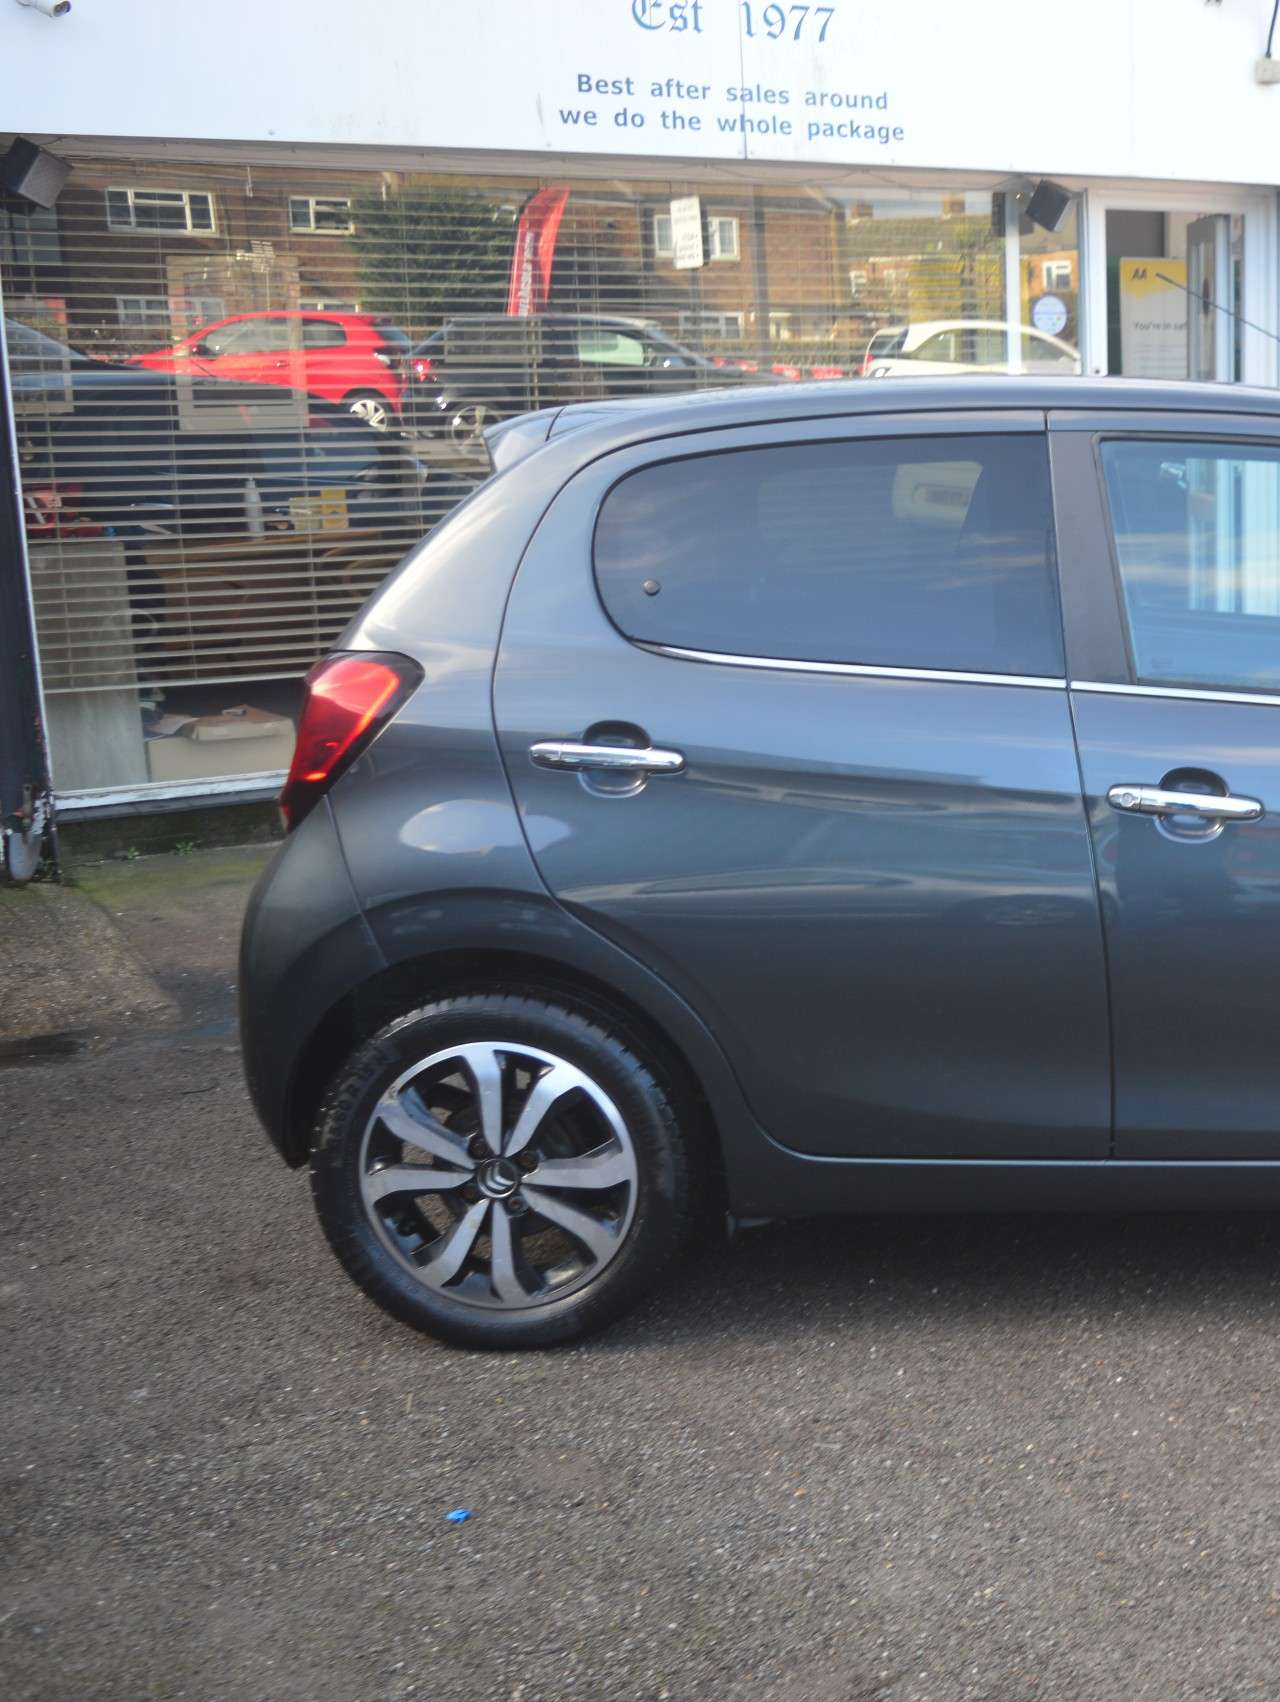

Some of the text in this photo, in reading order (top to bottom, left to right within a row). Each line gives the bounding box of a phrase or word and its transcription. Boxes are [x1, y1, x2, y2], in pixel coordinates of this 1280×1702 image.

[631, 0, 835, 42] Est 1977
[577, 73, 889, 110] Best after sales around
[559, 107, 905, 143] we do the whole package
